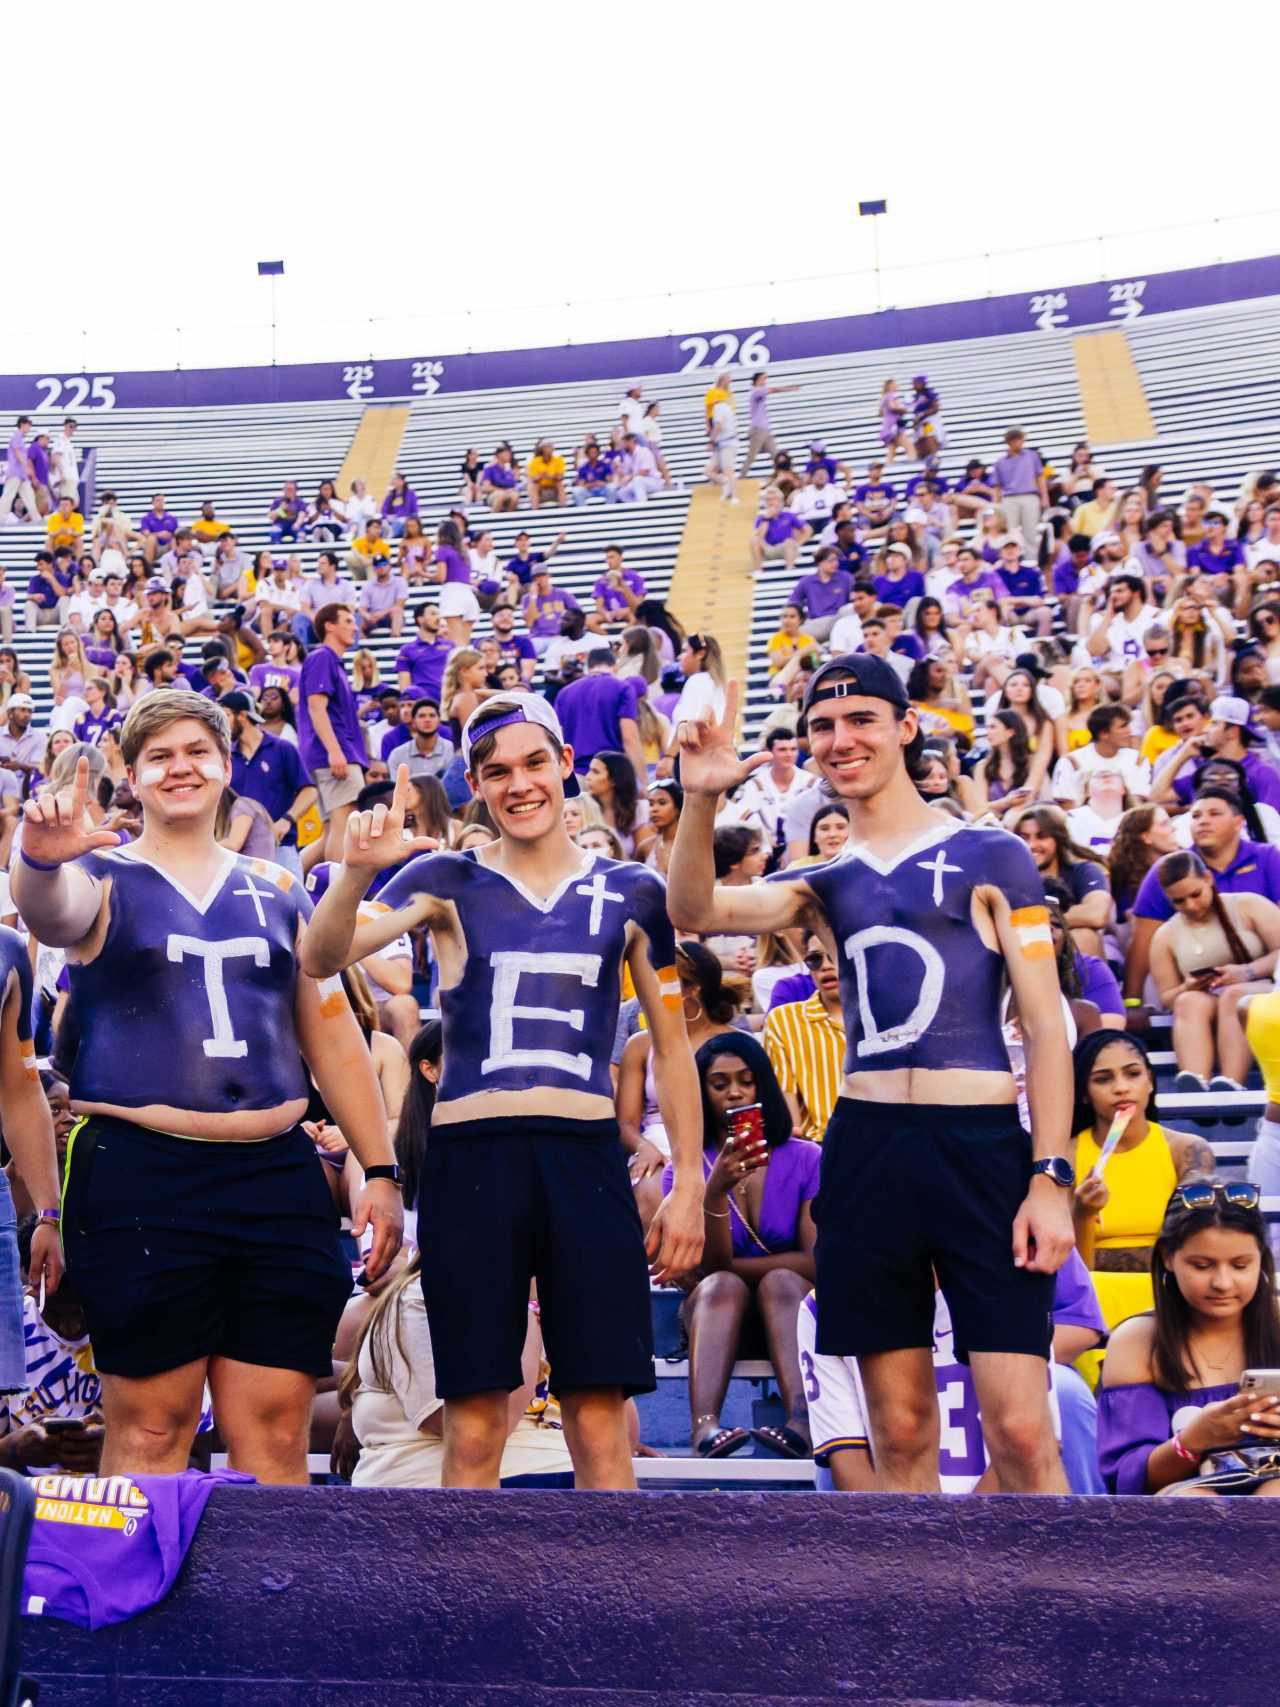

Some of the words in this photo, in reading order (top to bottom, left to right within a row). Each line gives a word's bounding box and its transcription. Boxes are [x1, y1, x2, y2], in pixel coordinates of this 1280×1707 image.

[1030, 293, 1067, 312] 226
[1109, 281, 1146, 301] 227
[680, 330, 770, 372] 226
[343, 366, 374, 381] 225
[412, 361, 444, 377] 226
[36, 376, 116, 411] 225
[166, 933, 271, 1058] T
[844, 925, 946, 1058] D
[481, 951, 603, 1081] E
